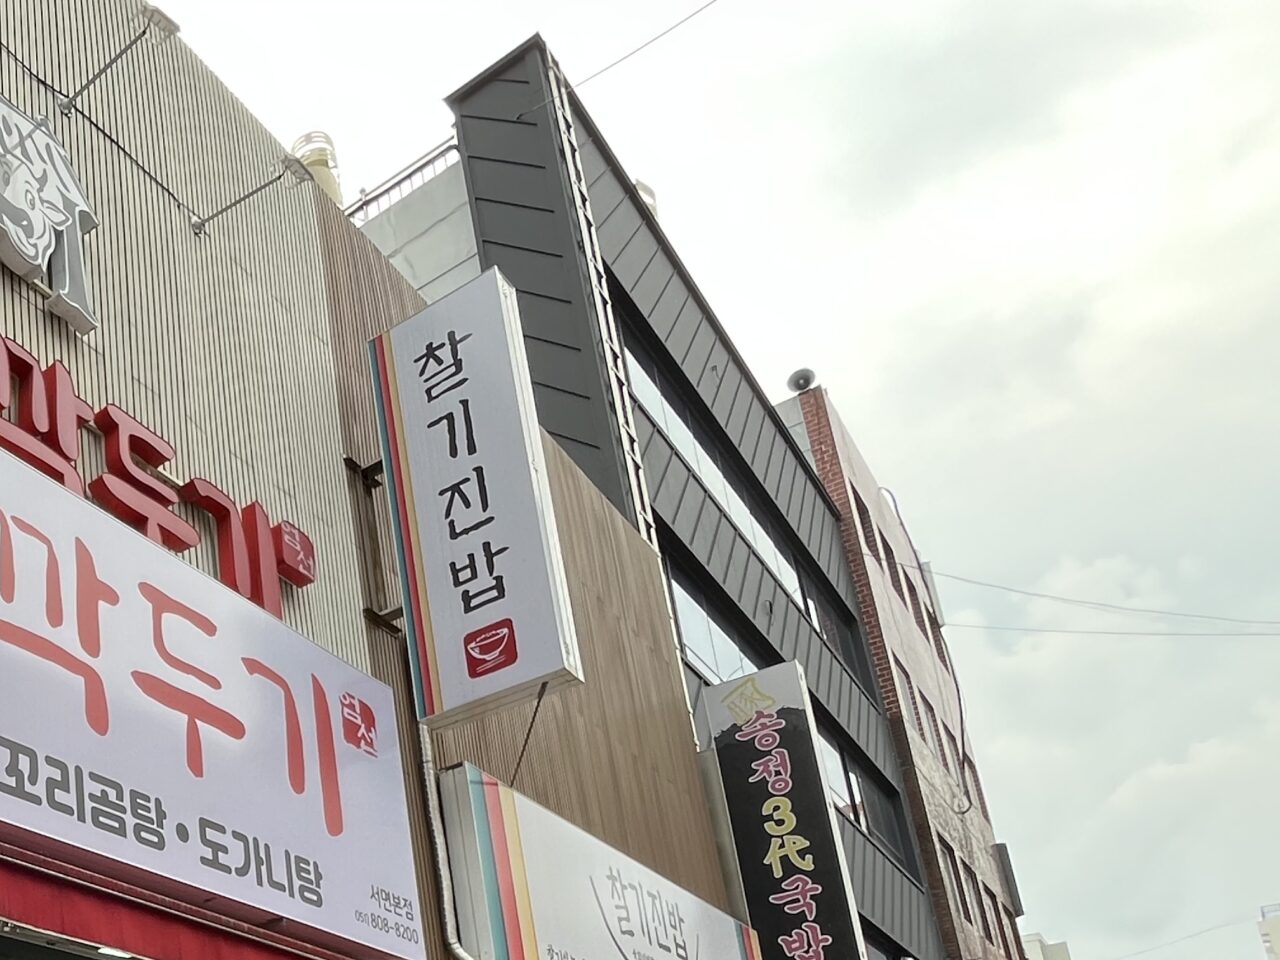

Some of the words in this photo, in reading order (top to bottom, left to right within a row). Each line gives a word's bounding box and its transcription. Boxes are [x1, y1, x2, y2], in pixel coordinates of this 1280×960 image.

[413, 330, 510, 614] 찰기진밥
[197, 815, 324, 910] 도가니탕
[370, 884, 414, 922] 서면본점
[370, 913, 419, 944] 808-8200
